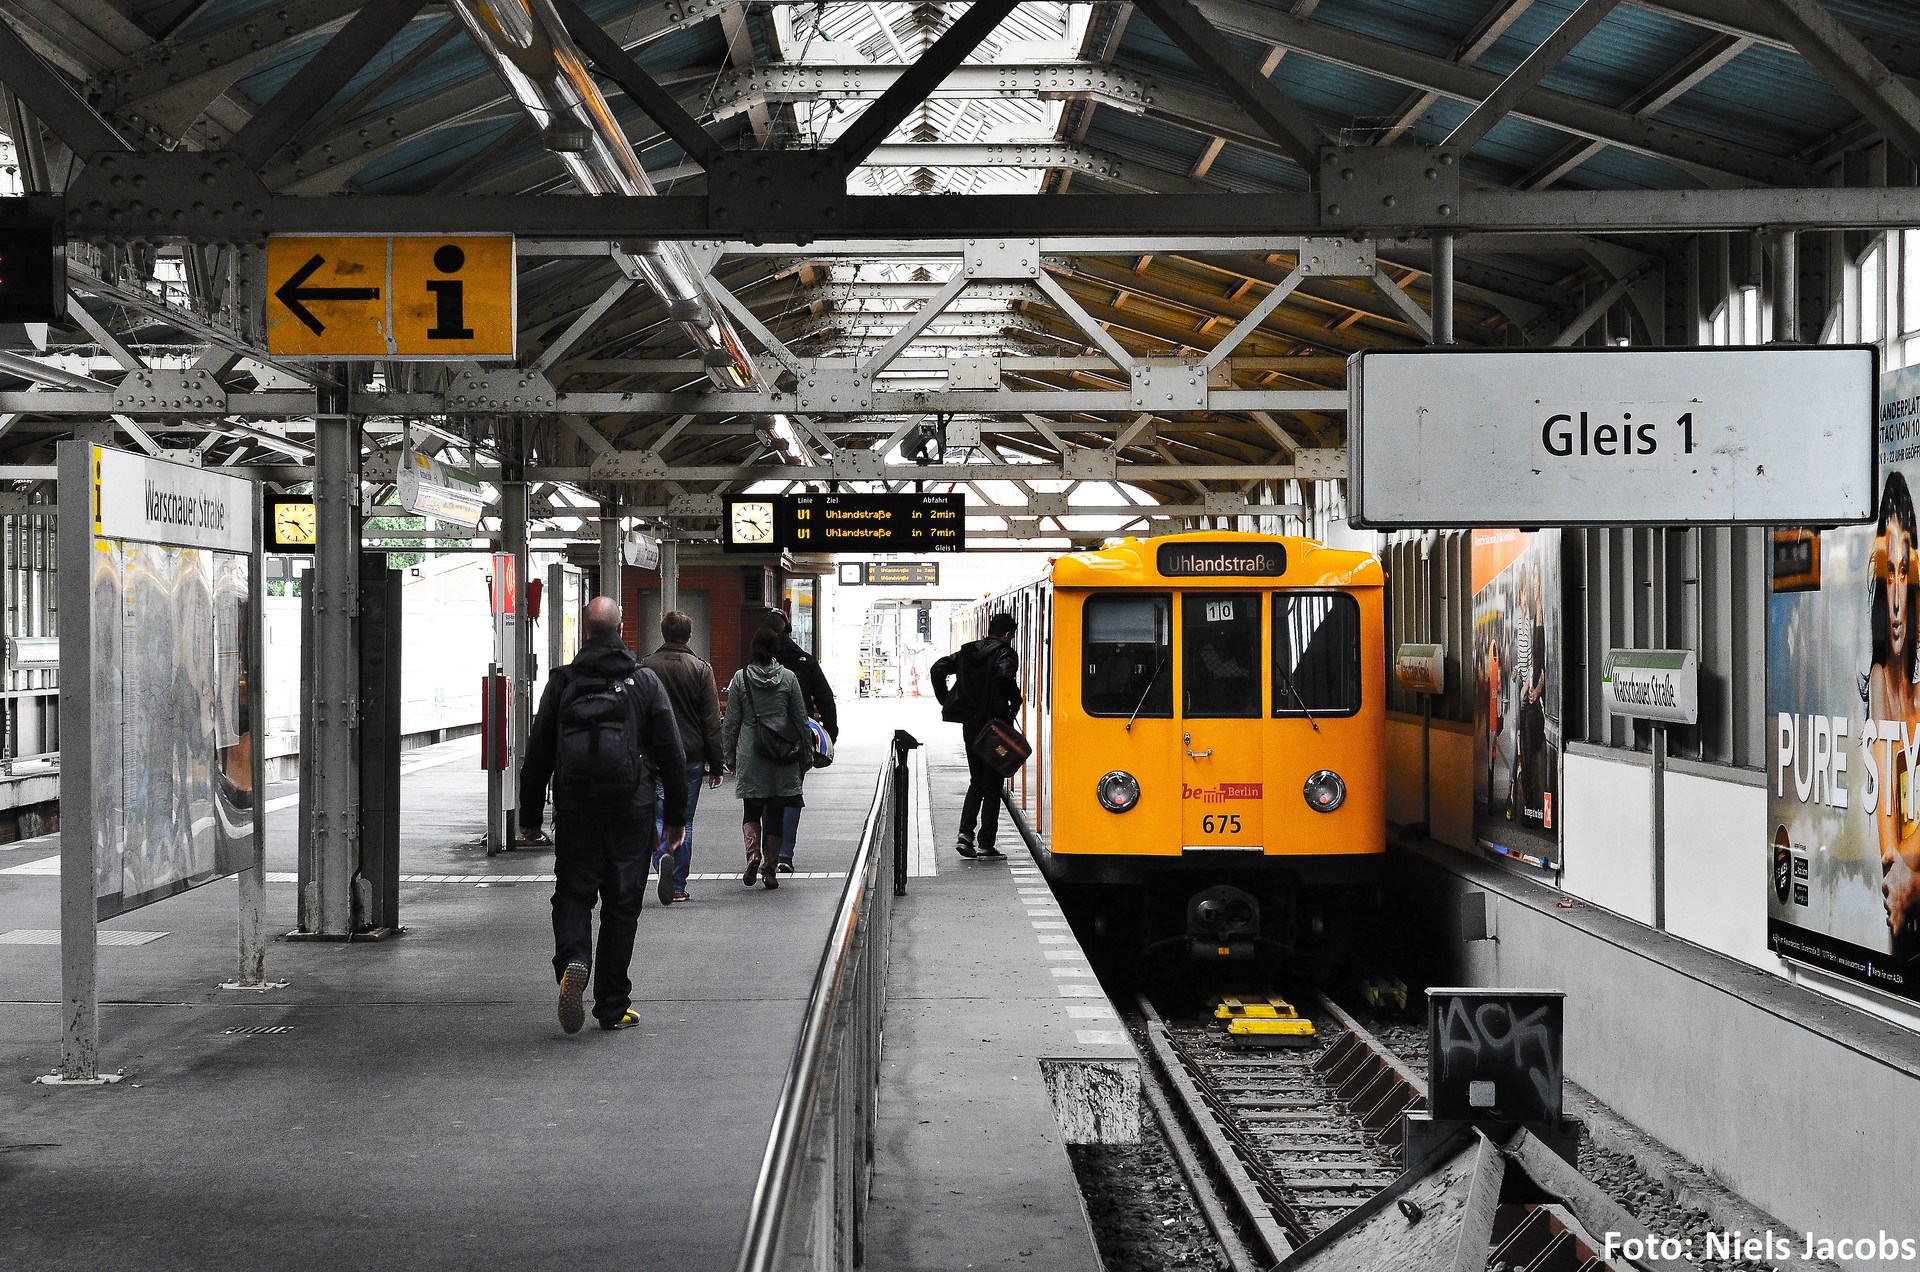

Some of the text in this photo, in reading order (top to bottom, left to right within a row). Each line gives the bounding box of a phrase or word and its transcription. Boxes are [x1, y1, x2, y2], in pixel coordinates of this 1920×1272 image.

[1542, 412, 1692, 456] Gleis 1
[1895, 421, 1910, 441] VON
[144, 478, 225, 530] Warschauer Straße
[797, 510, 955, 520] U1 Uhlandstraße in 2min
[797, 528, 955, 539] U1 Uhlandstraße in 7min
[1169, 554, 1275, 572] Uhlandstraße
[1209, 605, 1231, 619] 10
[1613, 672, 1676, 708] Warschauer Straße
[1778, 712, 1920, 820] PURE STY
[1227, 786, 1259, 797] Berlin
[1202, 814, 1242, 834] 675
